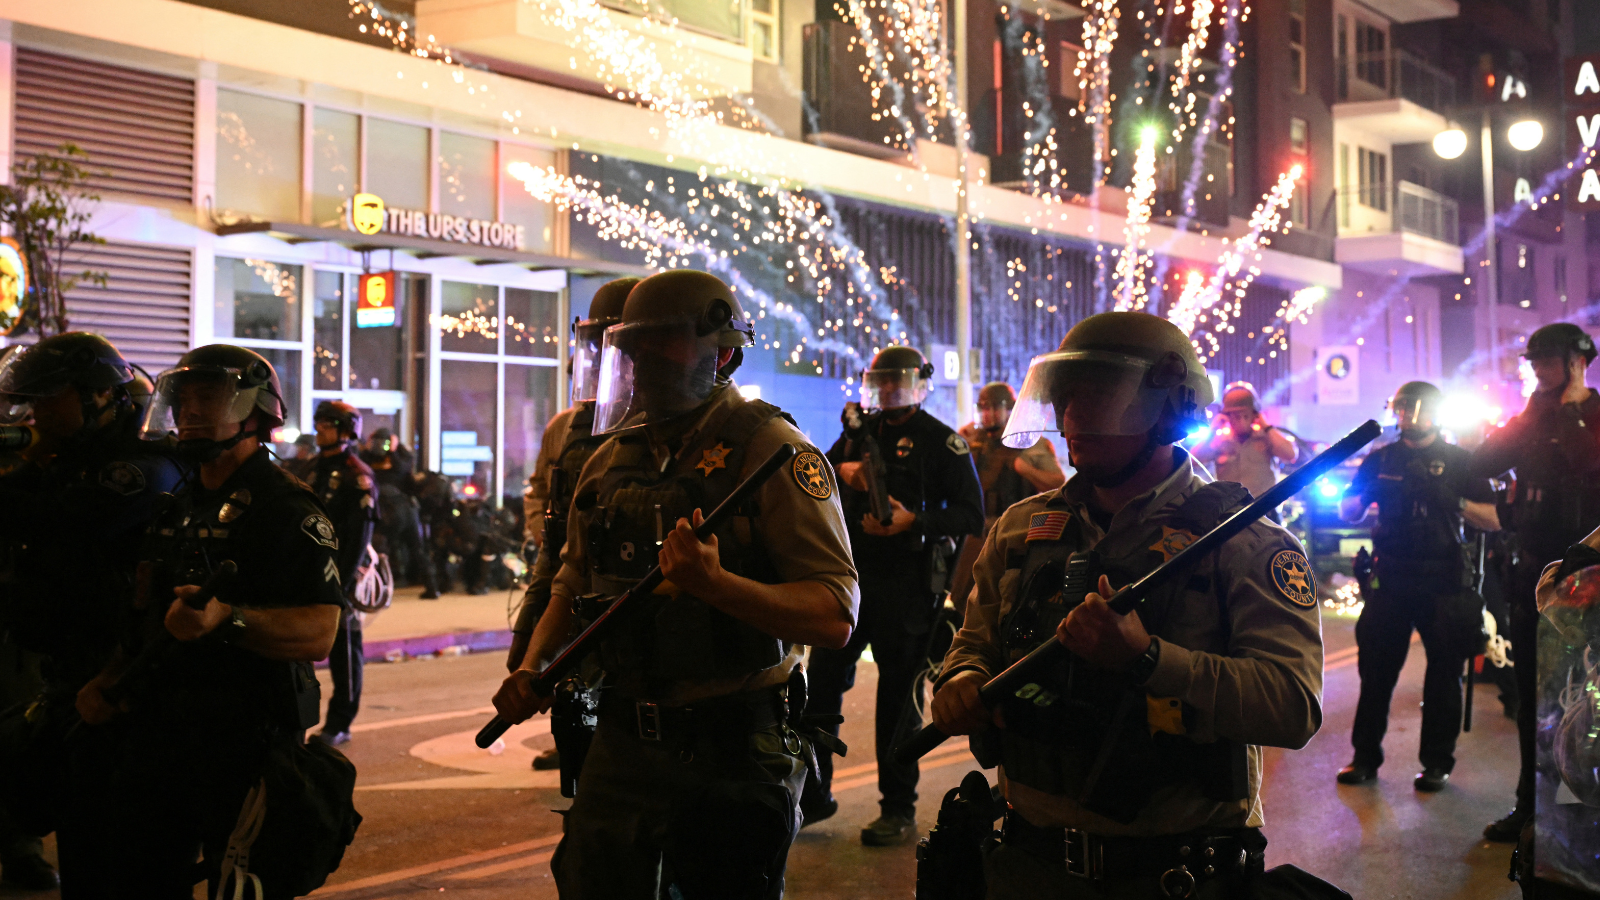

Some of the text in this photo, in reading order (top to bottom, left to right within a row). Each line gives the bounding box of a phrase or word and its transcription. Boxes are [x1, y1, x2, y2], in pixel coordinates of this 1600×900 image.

[388, 208, 525, 248] THE UPS STORE
[796, 454, 820, 471] VENTURA
[808, 485, 829, 495] COUNTY
[1275, 553, 1308, 572] VENTURA
[1284, 587, 1314, 603] COUNTY
